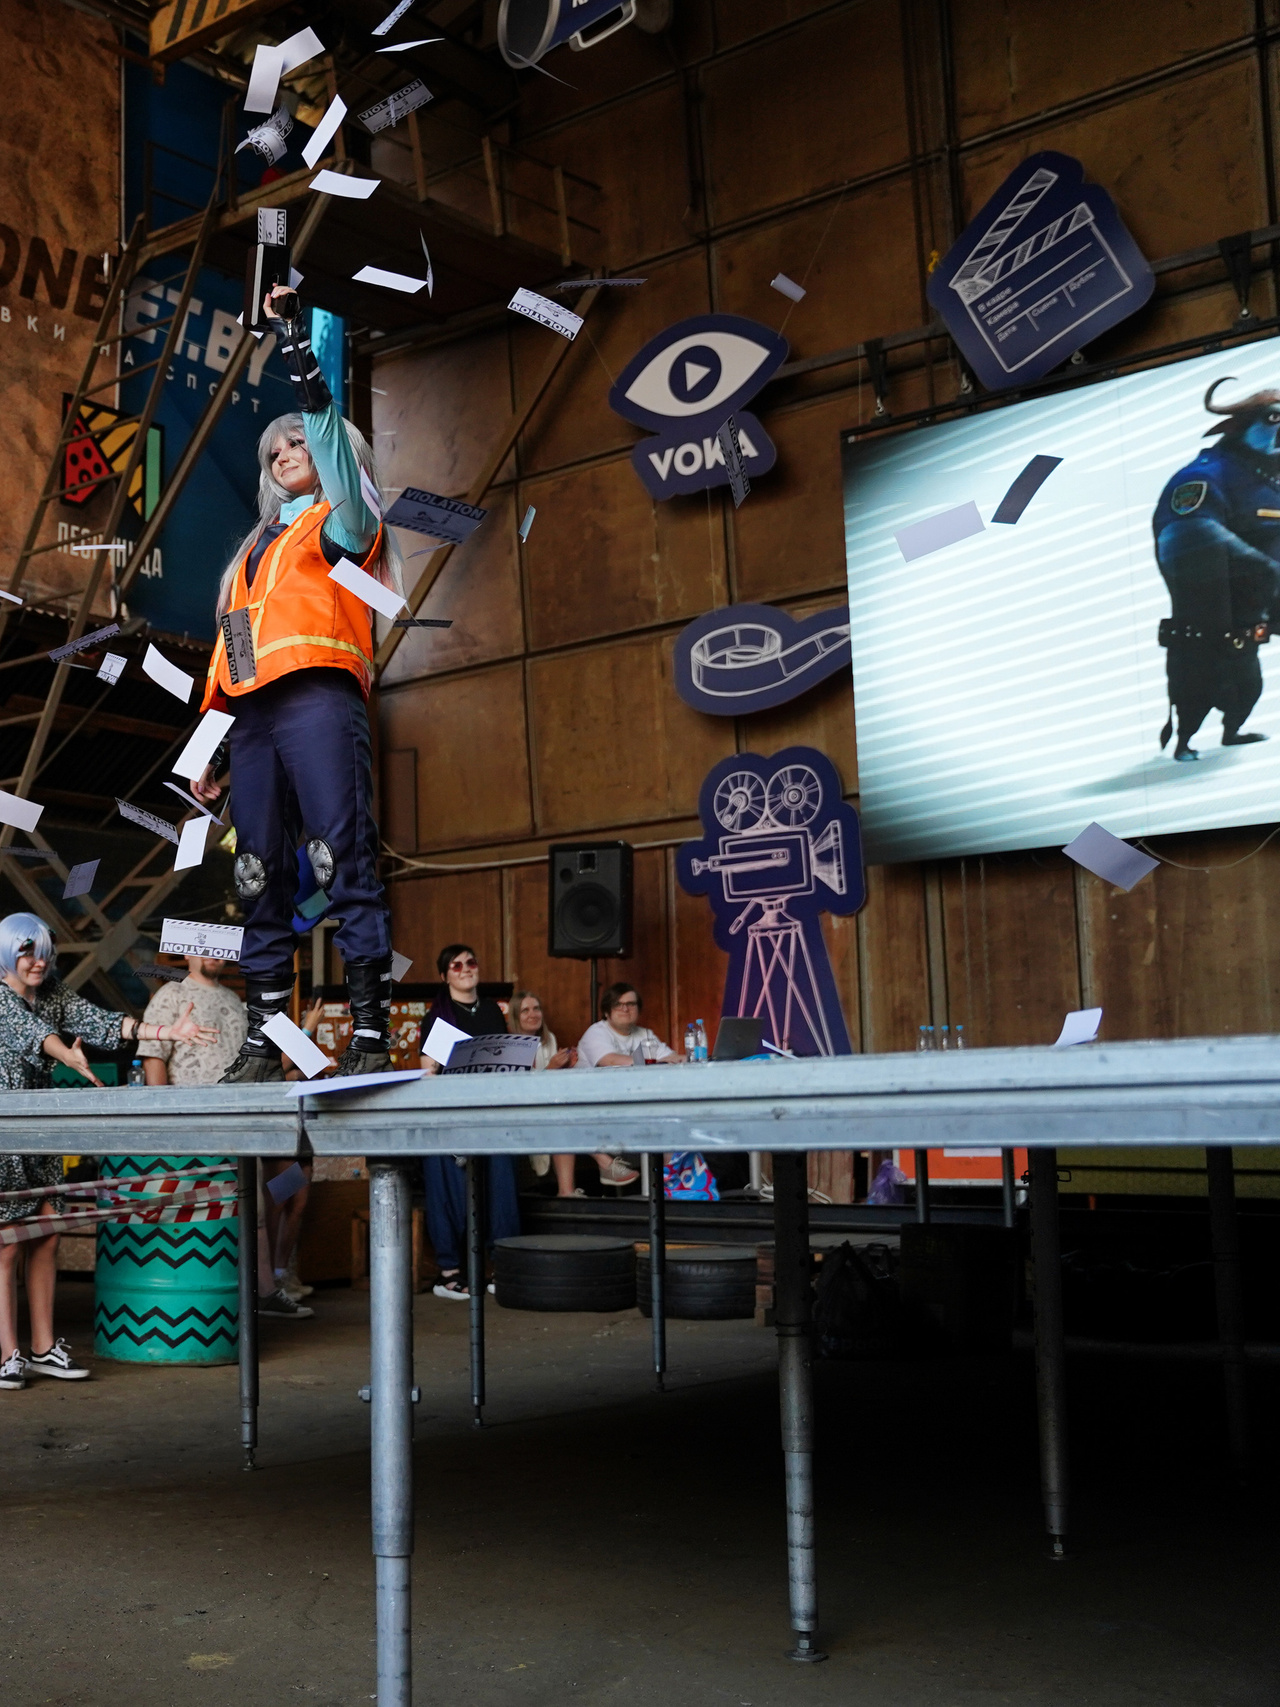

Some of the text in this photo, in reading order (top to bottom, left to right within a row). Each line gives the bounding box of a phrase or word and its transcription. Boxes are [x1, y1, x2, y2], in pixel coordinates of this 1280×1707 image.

[511, 302, 573, 339] VIOLATION
[986, 300, 1020, 326] Камера
[648, 428, 759, 482] VOKA
[405, 488, 486, 520] VIOLATION
[222, 615, 238, 685] VIOLATION
[118, 799, 175, 832] VIOLATION
[163, 942, 238, 960] VIOLATION
